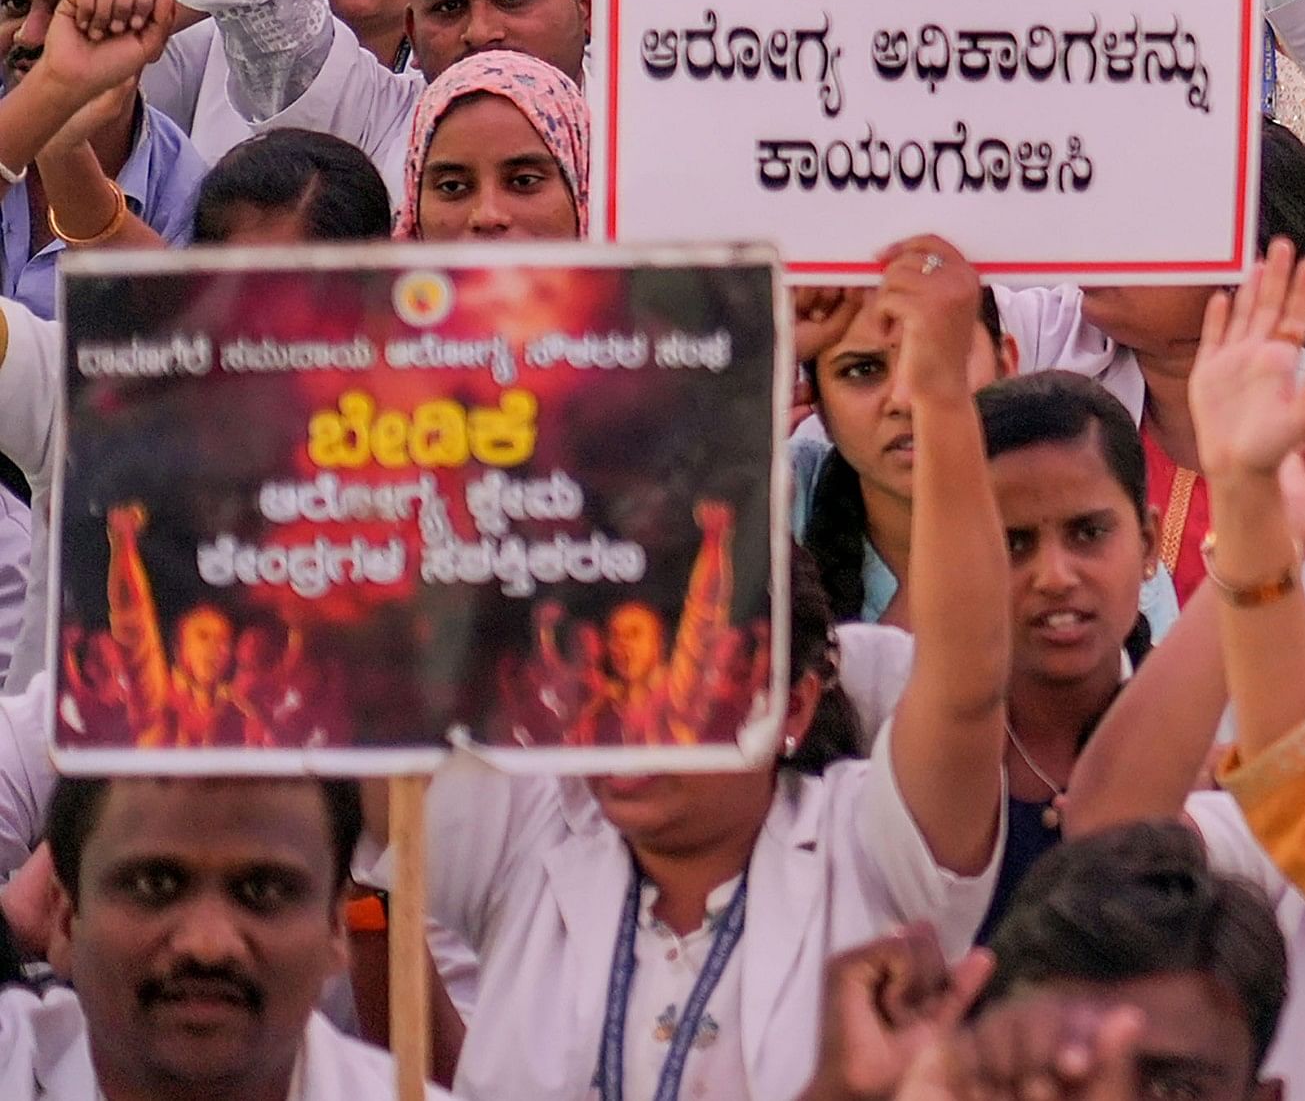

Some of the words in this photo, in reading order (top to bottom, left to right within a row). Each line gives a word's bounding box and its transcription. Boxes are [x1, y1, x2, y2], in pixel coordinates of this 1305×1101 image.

[642, 9, 842, 119] ಆರೋಗ್ಯ
[872, 18, 1210, 114] ಅಧಿಕಾರಿಗಳನ್ನು
[757, 120, 1093, 193] ಕಾಯಂಗೊಳಿಸಿ
[308, 390, 539, 469] ಬೇಡಿಕೆ
